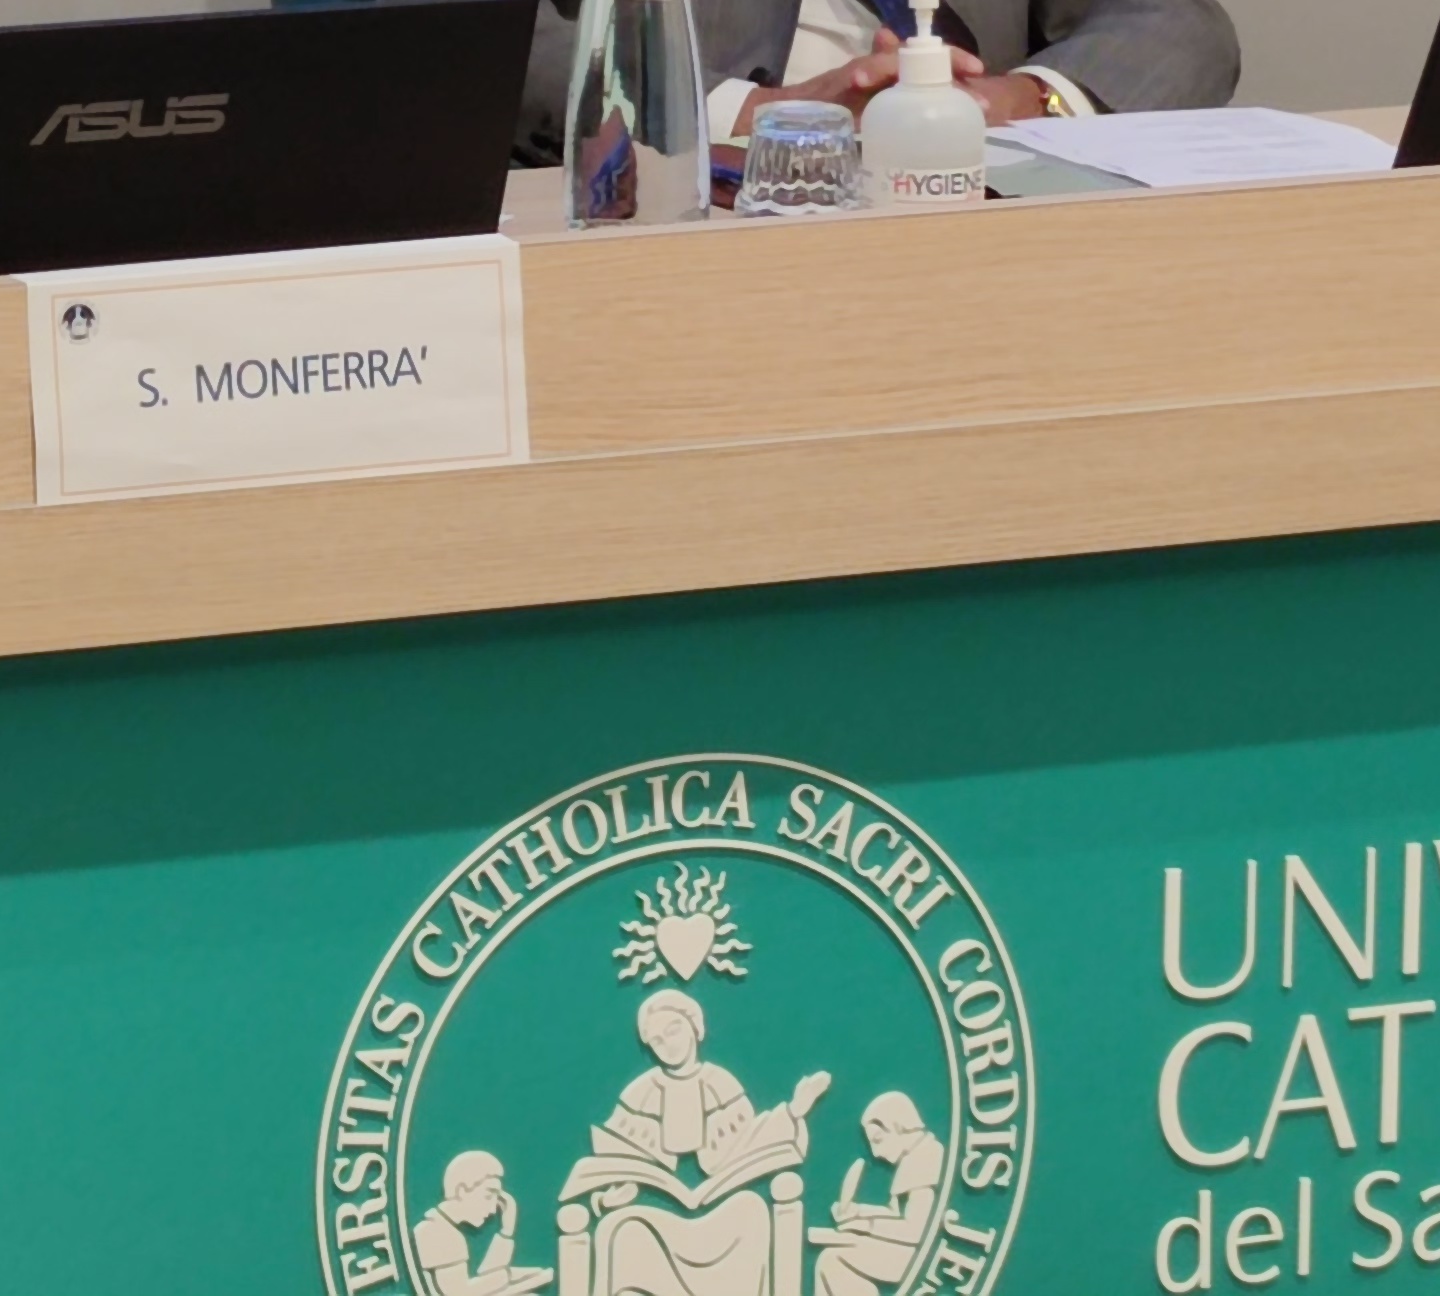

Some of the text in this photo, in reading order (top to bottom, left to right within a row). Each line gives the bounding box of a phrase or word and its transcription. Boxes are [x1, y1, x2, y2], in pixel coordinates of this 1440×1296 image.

[29, 93, 230, 146] ASUS
[136, 345, 429, 409] S. MONFERRA'
[333, 769, 1021, 1296] ERSITAS CATHOLICA SACRI CORDIS JE
[1155, 1176, 1312, 1294] del
